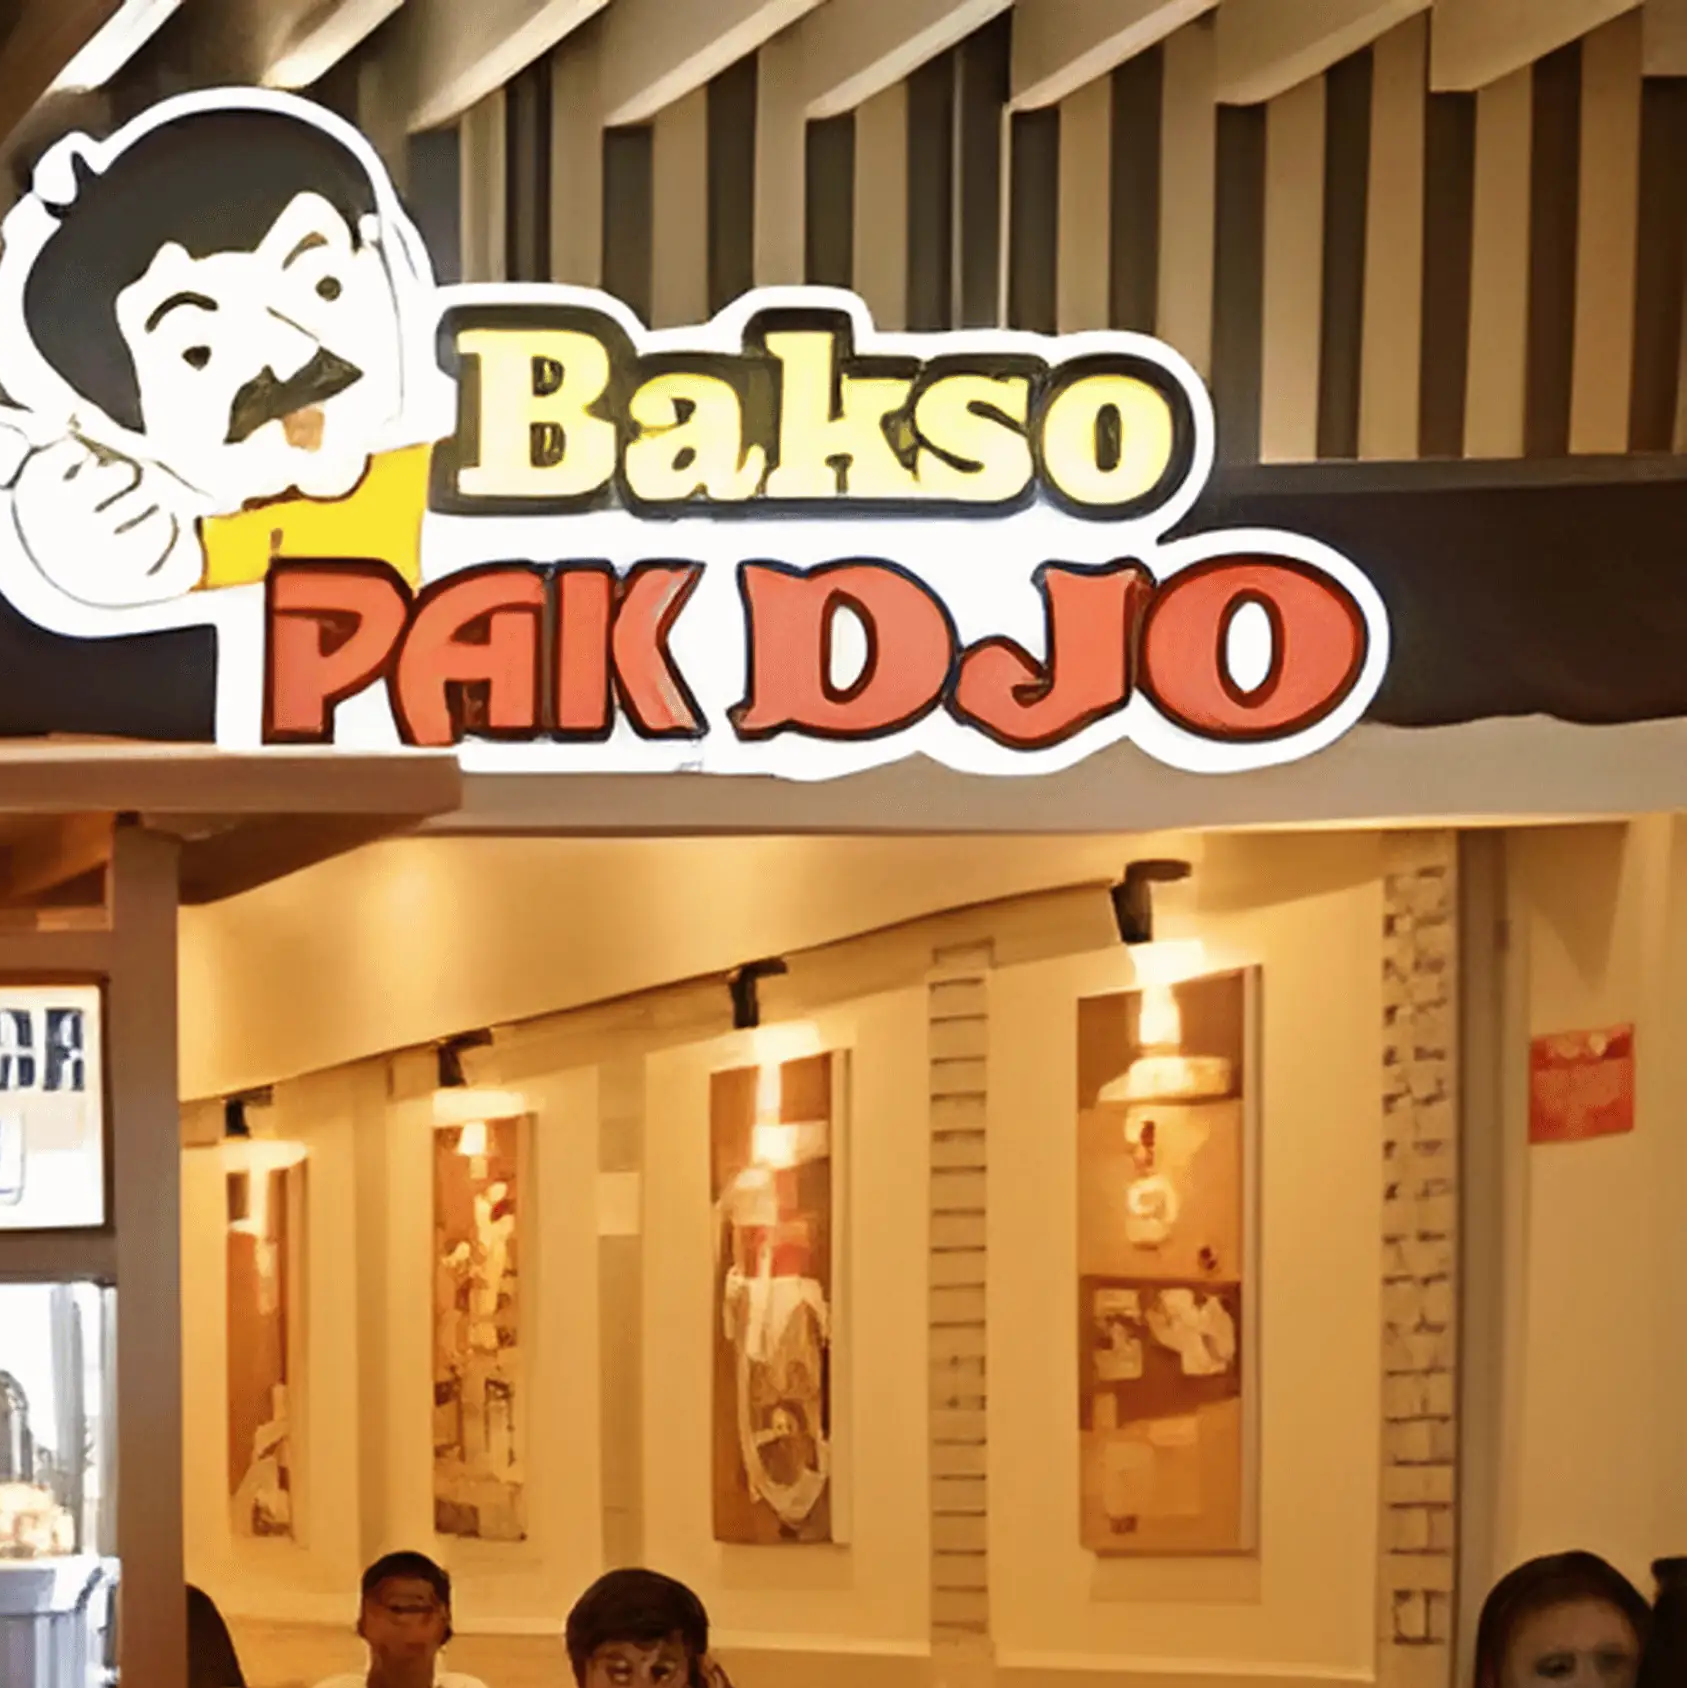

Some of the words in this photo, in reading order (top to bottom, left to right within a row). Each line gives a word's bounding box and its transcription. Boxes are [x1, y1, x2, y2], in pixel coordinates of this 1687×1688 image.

[450, 322, 1178, 508] Bakso
[262, 556, 706, 748] PAK
[732, 550, 1374, 752] DJO
